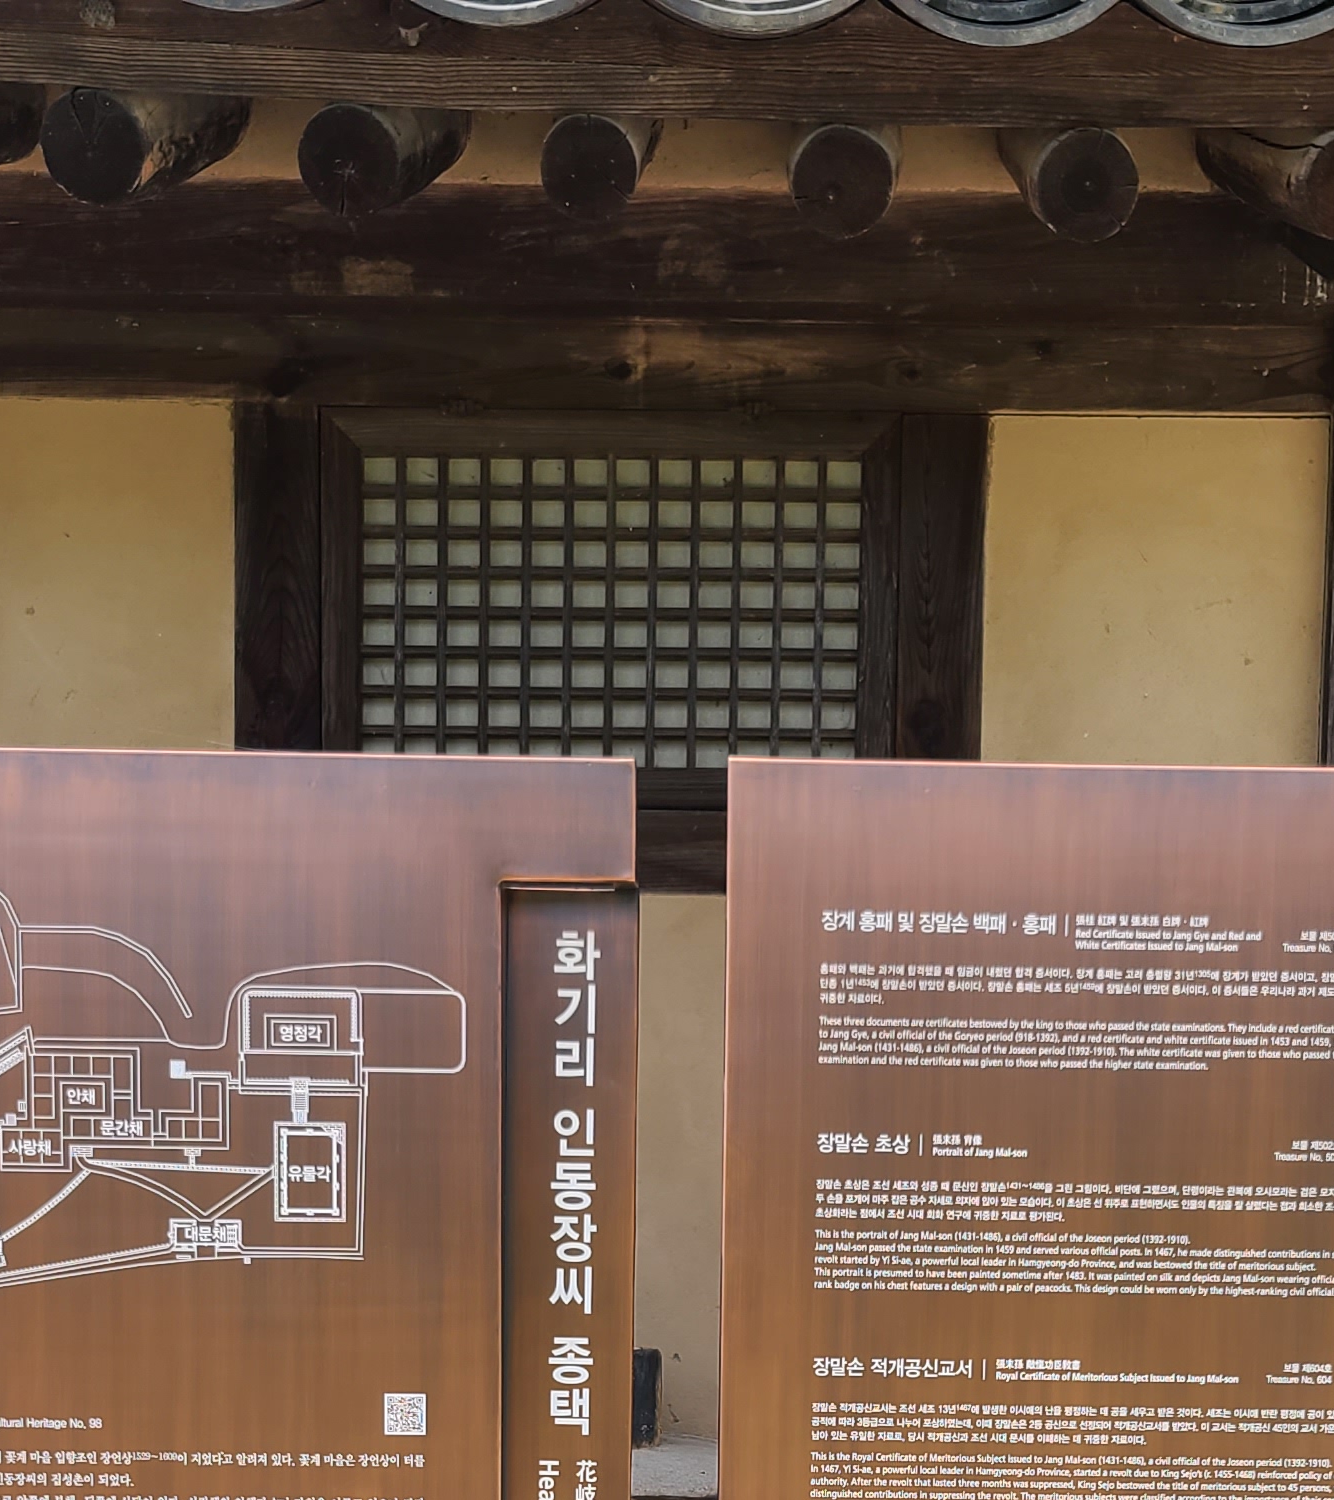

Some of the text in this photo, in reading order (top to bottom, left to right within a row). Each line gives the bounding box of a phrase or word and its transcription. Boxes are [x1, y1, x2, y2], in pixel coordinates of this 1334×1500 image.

[821, 909, 855, 931] 장계
[858, 910, 892, 932] 홍패
[898, 910, 914, 932] 및
[918, 911, 969, 933] 장말손
[973, 912, 1006, 934] 백패
[1022, 912, 1056, 935] 홍패
[1074, 928, 1091, 939] Red
[1091, 929, 1133, 939] Certificate
[1135, 929, 1160, 940] Issued
[1173, 930, 1192, 942] Jang
[1193, 931, 1209, 942] Gye
[1211, 930, 1227, 941] and
[1228, 931, 1245, 941] Red
[1245, 931, 1262, 942] and
[1074, 940, 1099, 949] White
[1101, 940, 1146, 950] Certificates
[1147, 940, 1173, 950] Issued
[1184, 940, 1204, 954] Jang
[1205, 941, 1238, 952] Mal-son
[279, 1024, 322, 1042] 영정각
[67, 1087, 95, 1106] 안채
[101, 1119, 143, 1138] 문간채
[9, 1137, 51, 1157] 사랑채
[816, 1132, 869, 1153] 장말손
[874, 1133, 910, 1154] 초상
[932, 1146, 963, 1156] Portrait
[974, 1147, 994, 1159] Jang
[994, 1146, 1027, 1157] Mal-son
[289, 1164, 331, 1182] 유물각
[548, 931, 600, 1436] 화기리 인동장씨 종택
[184, 1225, 227, 1244] 대문채
[812, 1356, 864, 1376] 장말손
[870, 1357, 972, 1378] 적개공신교서
[995, 1371, 1018, 1382] Royal
[1019, 1371, 1060, 1381] Certificate
[1071, 1372, 1118, 1382] Meritorious
[1119, 1372, 1149, 1384] Subject
[1149, 1373, 1175, 1382] Issued
[1186, 1374, 1206, 1385] Jang
[1206, 1373, 1239, 1383] Mal-son
[25, 1417, 67, 1429] Heritage
[69, 1417, 86, 1429] No.
[88, 1417, 102, 1428] 98
[50, 1472, 93, 1486] 집성촌이
[97, 1472, 134, 1487] 되었다.
